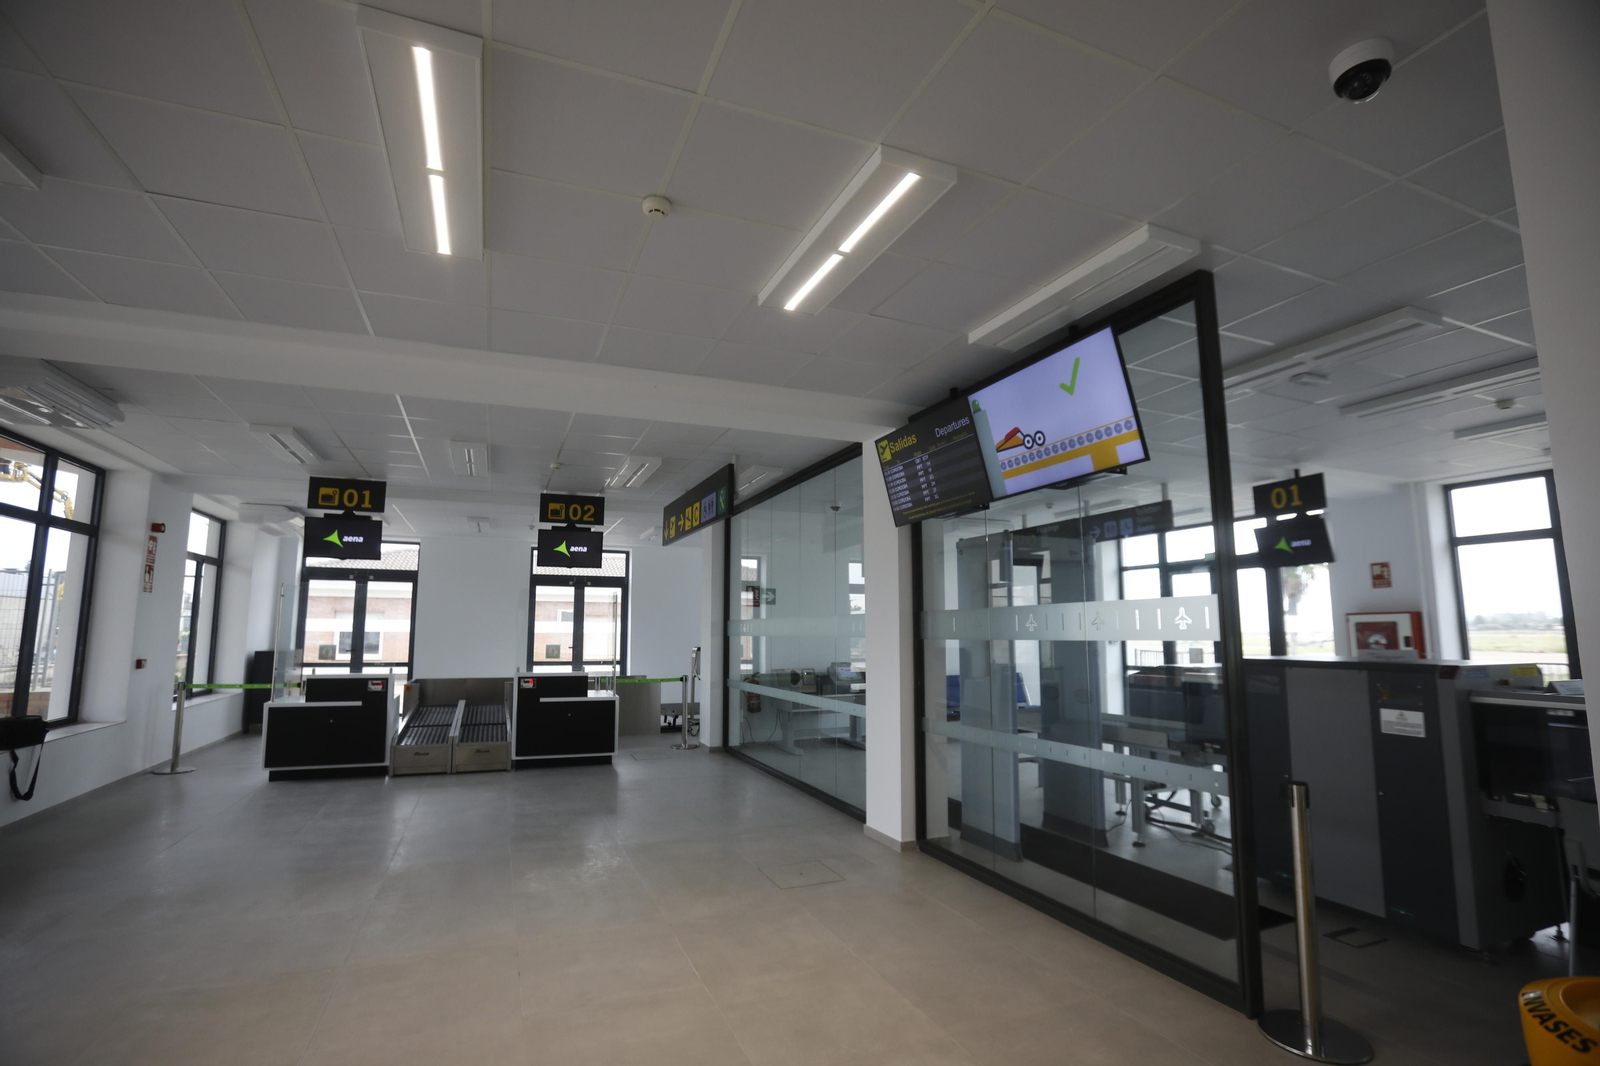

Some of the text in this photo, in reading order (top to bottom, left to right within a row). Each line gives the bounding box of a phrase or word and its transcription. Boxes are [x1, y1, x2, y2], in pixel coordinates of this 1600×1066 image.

[935, 416, 970, 438] Departures
[889, 434, 917, 454] Salidas
[343, 489, 372, 508] 01
[1271, 485, 1302, 508] 01
[569, 504, 595, 521] 02
